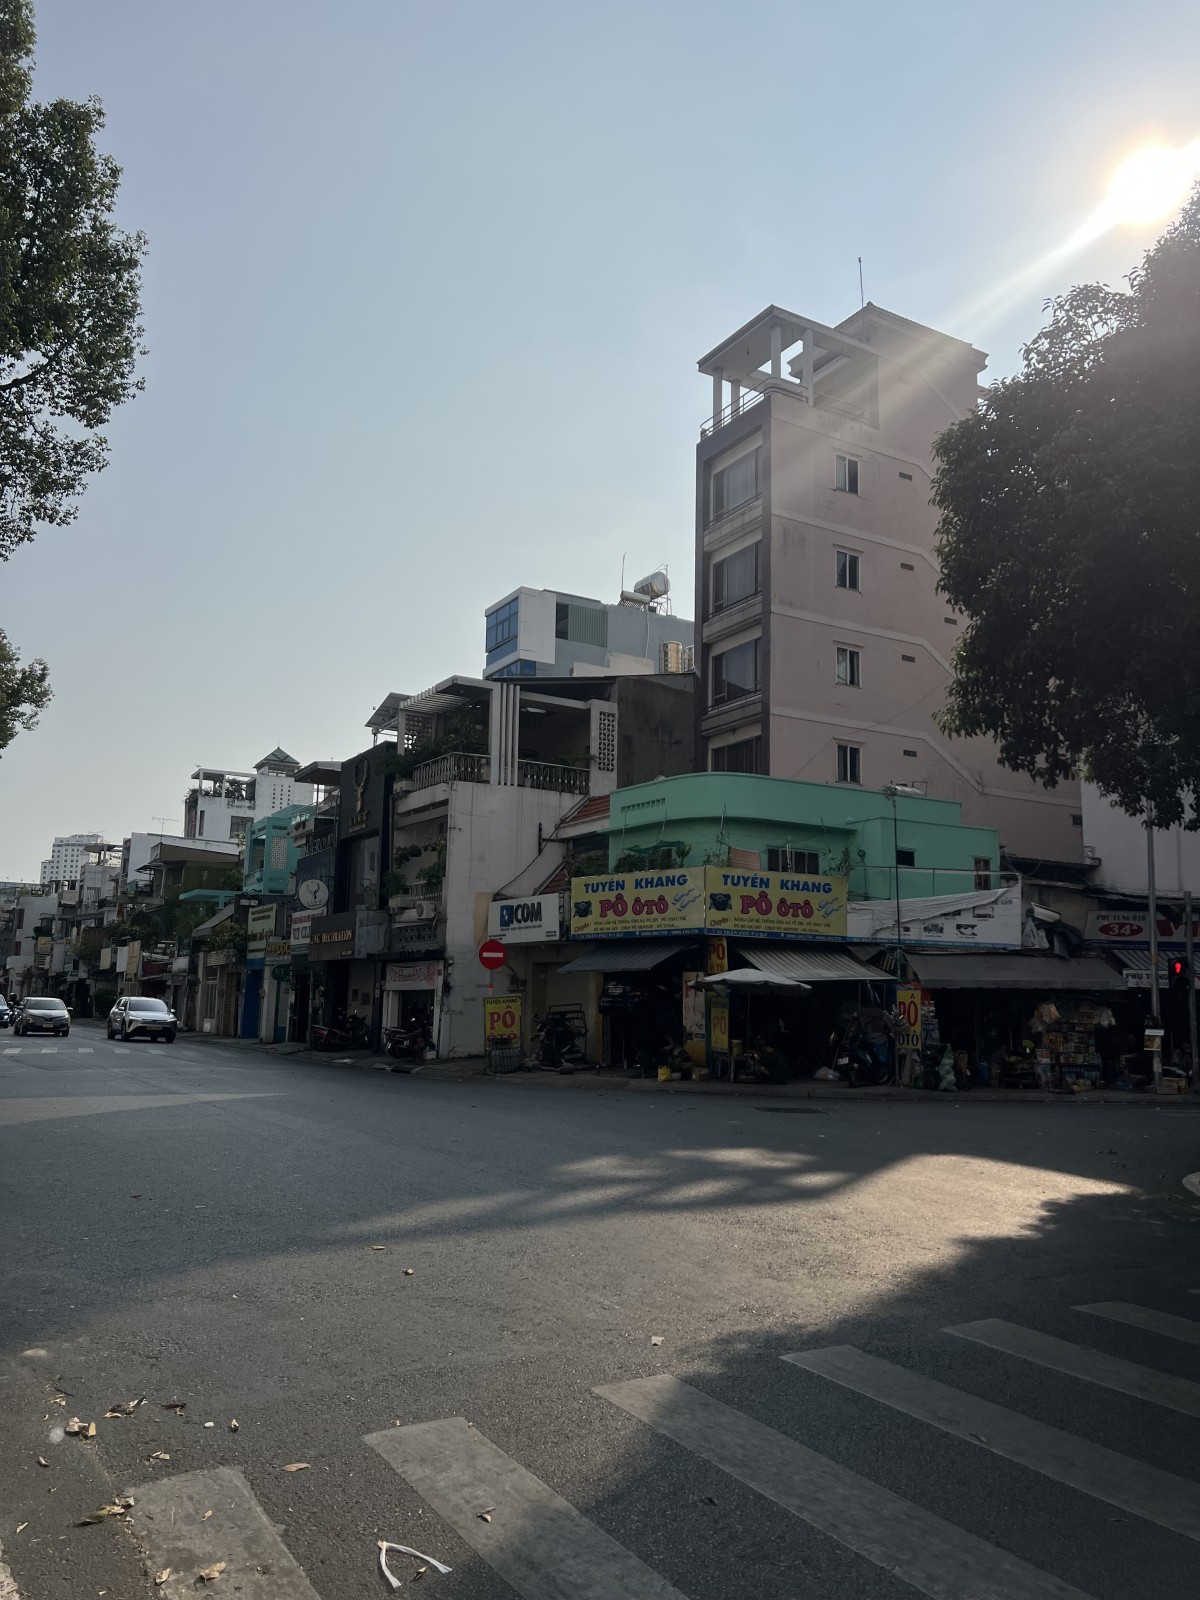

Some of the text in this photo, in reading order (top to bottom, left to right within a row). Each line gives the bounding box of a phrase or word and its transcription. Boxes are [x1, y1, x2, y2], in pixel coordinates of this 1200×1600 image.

[635, 874, 688, 889] KHANG
[780, 879, 832, 894] KHANG
[599, 893, 669, 918] PÔ ÔTÔ
[740, 891, 814, 918] PÔ ÔTÔ
[709, 938, 726, 961] PÔ
[489, 1004, 516, 1030] PÔ
[898, 993, 918, 1027] PÔ
